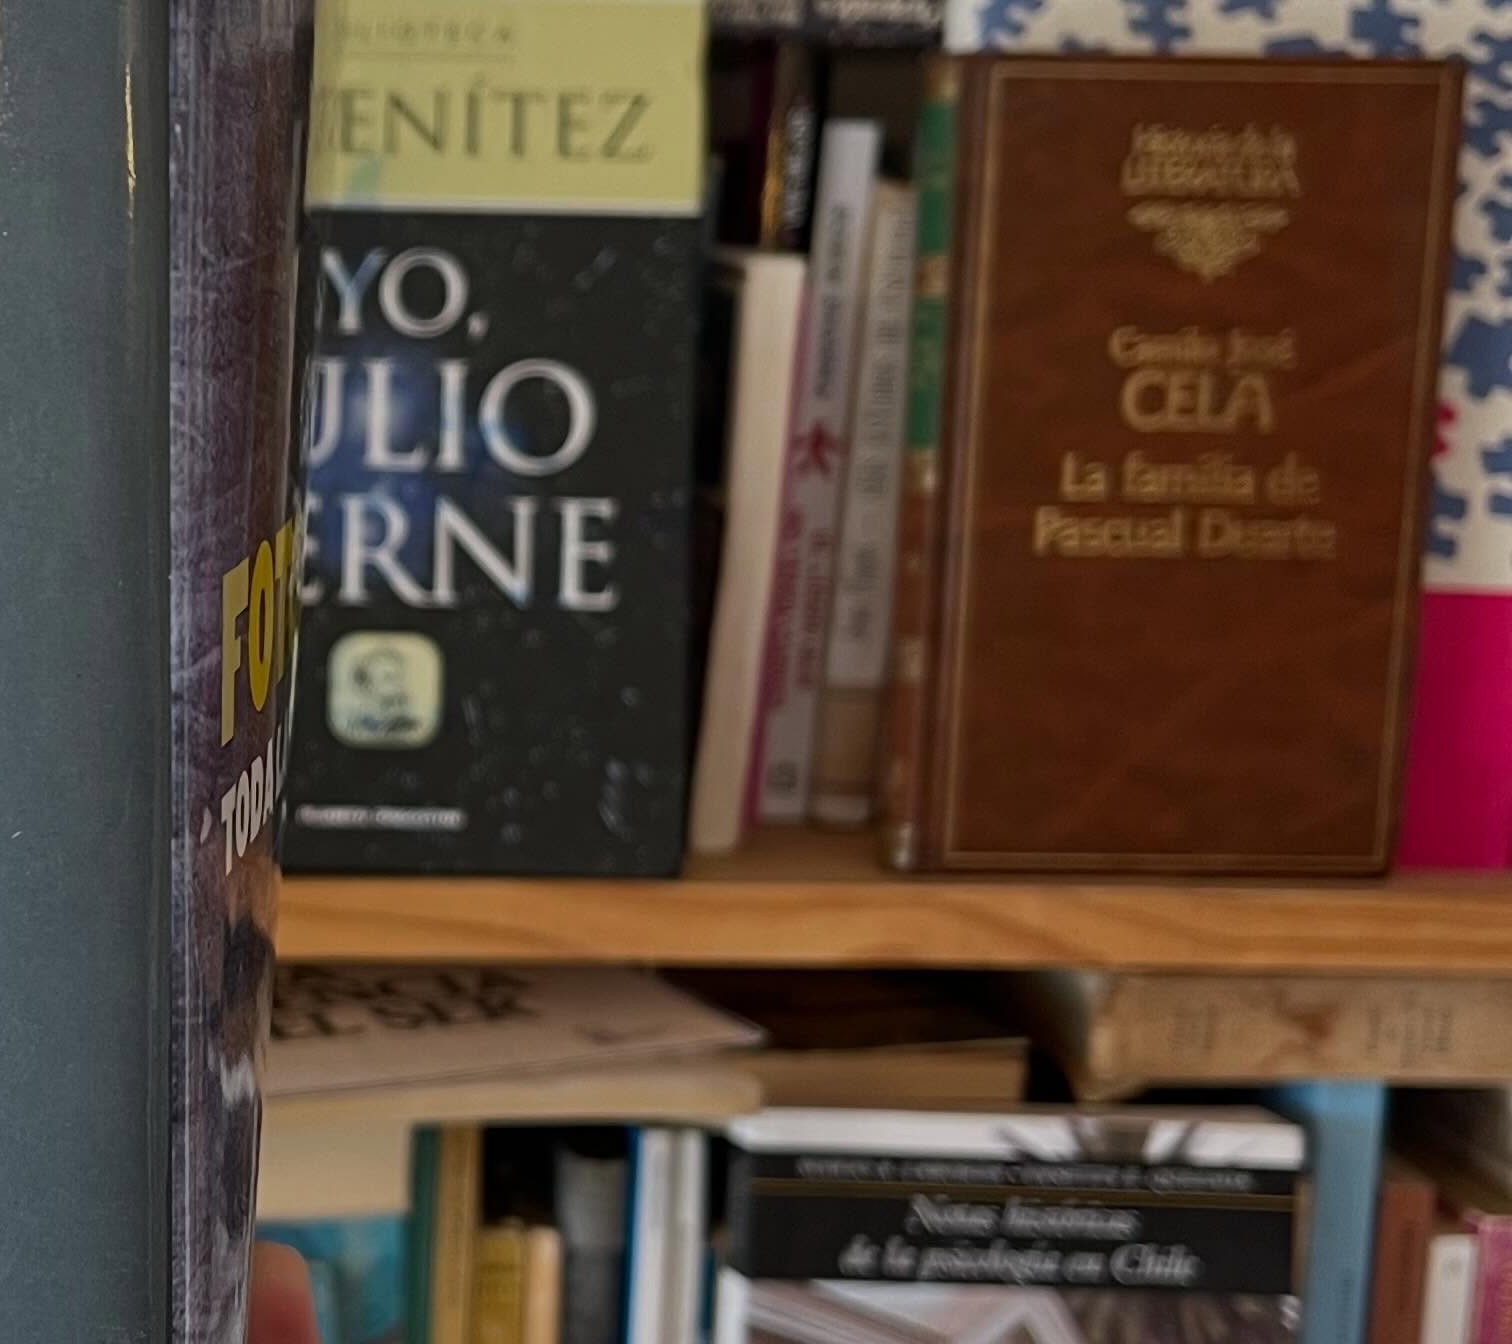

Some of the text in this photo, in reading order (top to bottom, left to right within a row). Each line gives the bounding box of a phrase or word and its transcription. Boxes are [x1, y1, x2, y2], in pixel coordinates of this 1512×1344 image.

[328, 72, 655, 164] ENÍTEZ
[306, 356, 597, 478] ULIO
[1123, 370, 1278, 433] CELA
[298, 491, 621, 613] RNE
